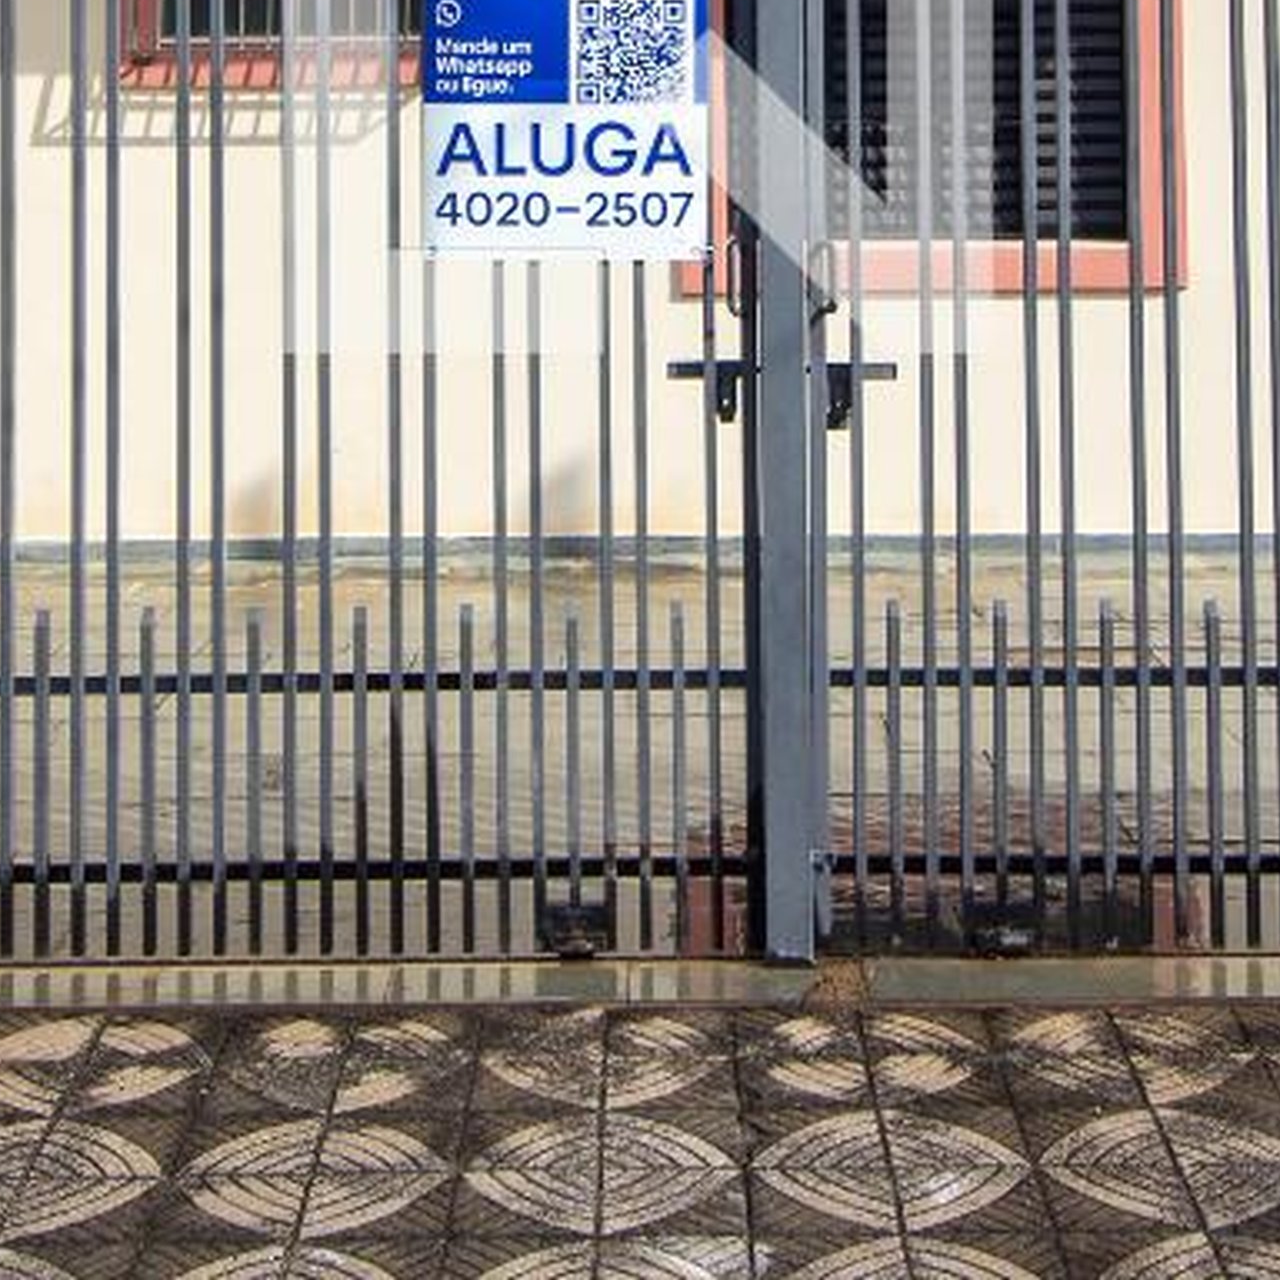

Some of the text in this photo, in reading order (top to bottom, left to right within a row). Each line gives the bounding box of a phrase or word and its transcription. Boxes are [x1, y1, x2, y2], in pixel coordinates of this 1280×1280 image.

[435, 36, 532, 54] Mande um
[435, 56, 533, 77] Whatsapp
[435, 79, 458, 94] ou
[435, 121, 694, 177] ALUGA
[435, 192, 695, 228] 4020-2507
